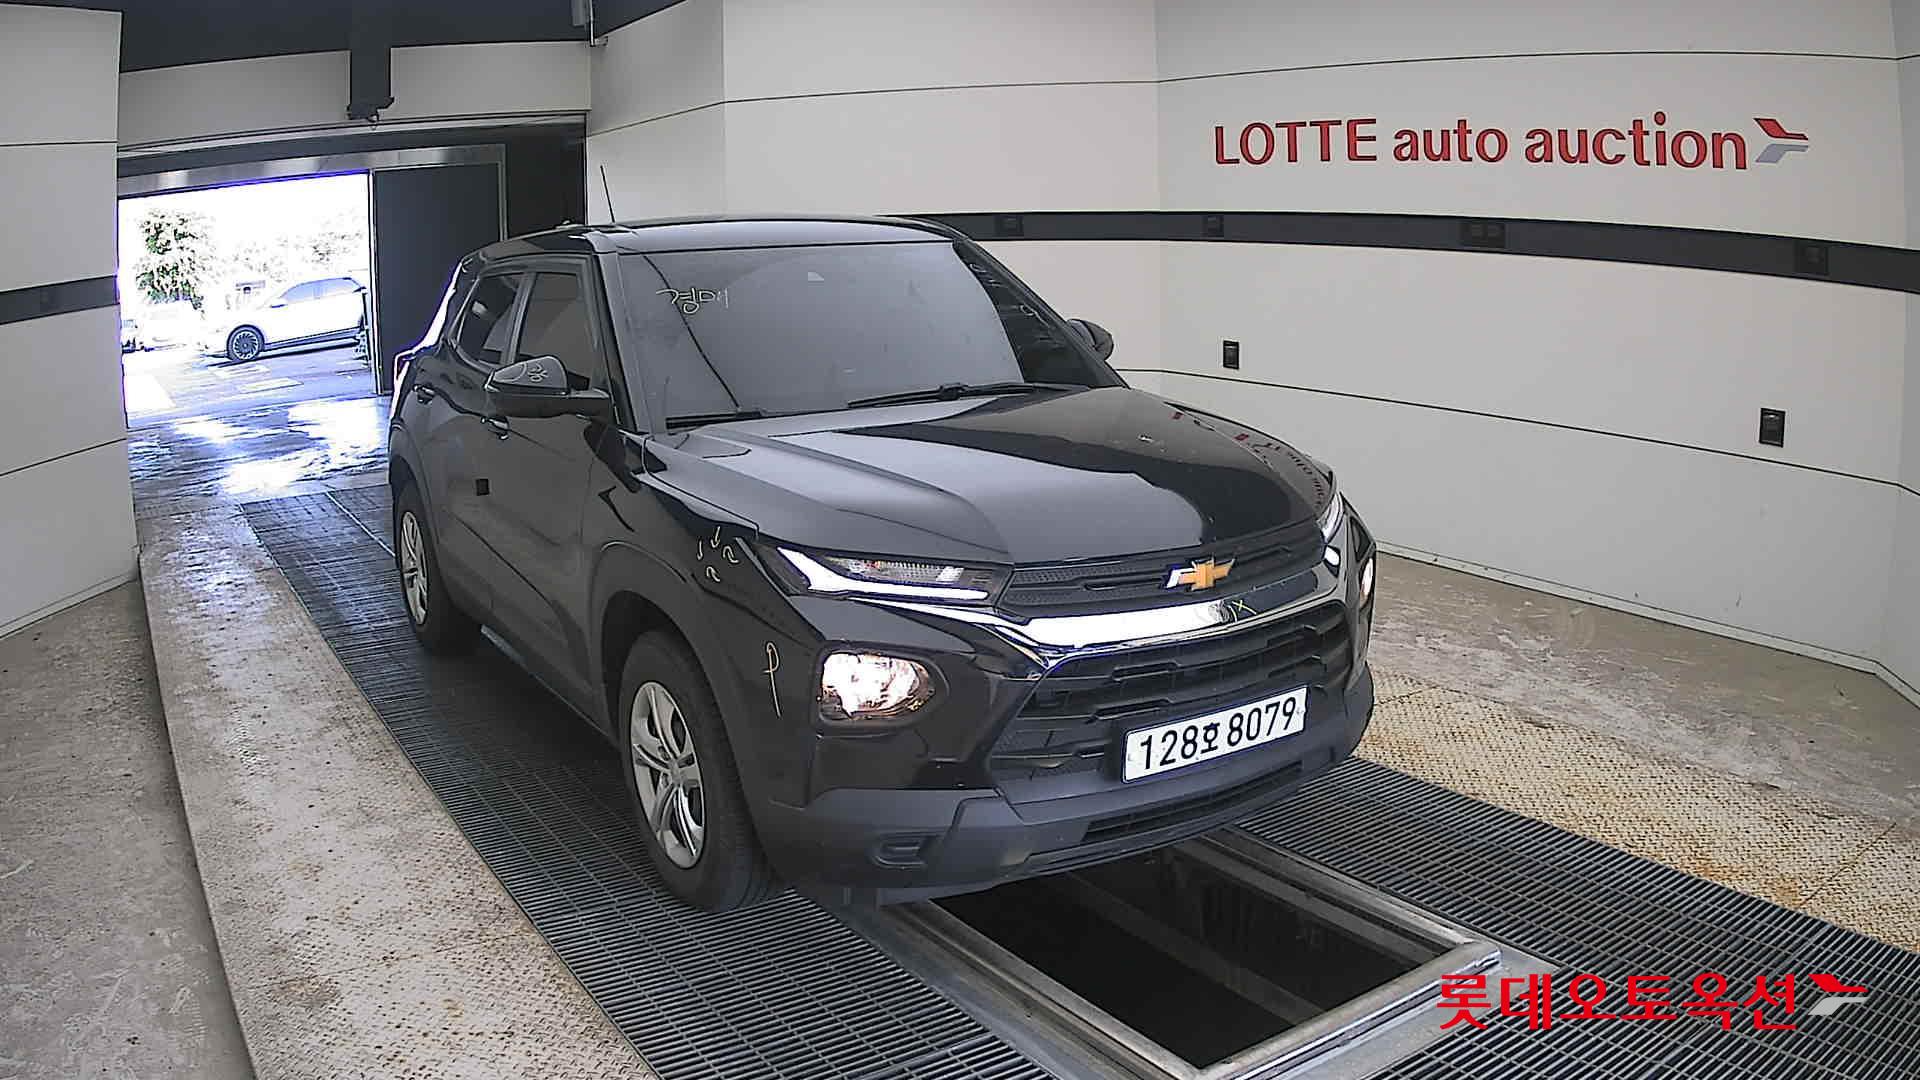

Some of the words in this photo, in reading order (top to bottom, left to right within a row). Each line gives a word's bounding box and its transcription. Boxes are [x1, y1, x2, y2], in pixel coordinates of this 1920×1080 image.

[1215, 118, 1377, 166] LOTTE
[1392, 119, 1510, 163] auto
[1524, 111, 1748, 170] auction
[1140, 721, 1221, 770] 128호
[1226, 696, 1297, 748] 8079
